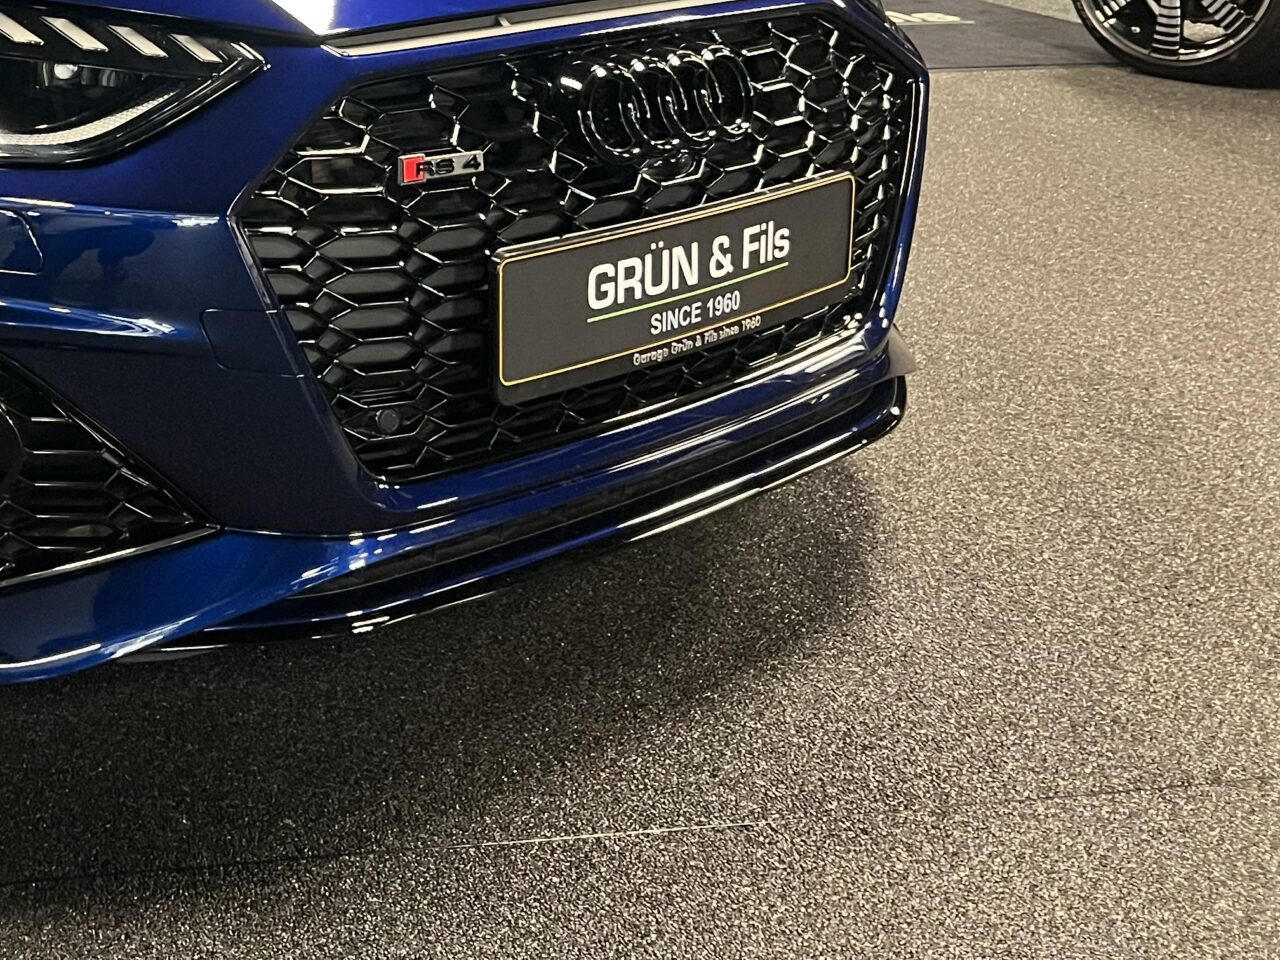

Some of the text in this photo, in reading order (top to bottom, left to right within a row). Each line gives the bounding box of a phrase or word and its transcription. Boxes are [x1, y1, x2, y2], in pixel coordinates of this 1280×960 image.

[415, 154, 482, 179] RS 4
[587, 220, 790, 310] GRÜN & Fils
[650, 290, 741, 335] SINCE 1960
[633, 348, 669, 366] Garage
[695, 335, 702, 347] &
[704, 330, 718, 345] Fils
[741, 315, 761, 332] 1960
